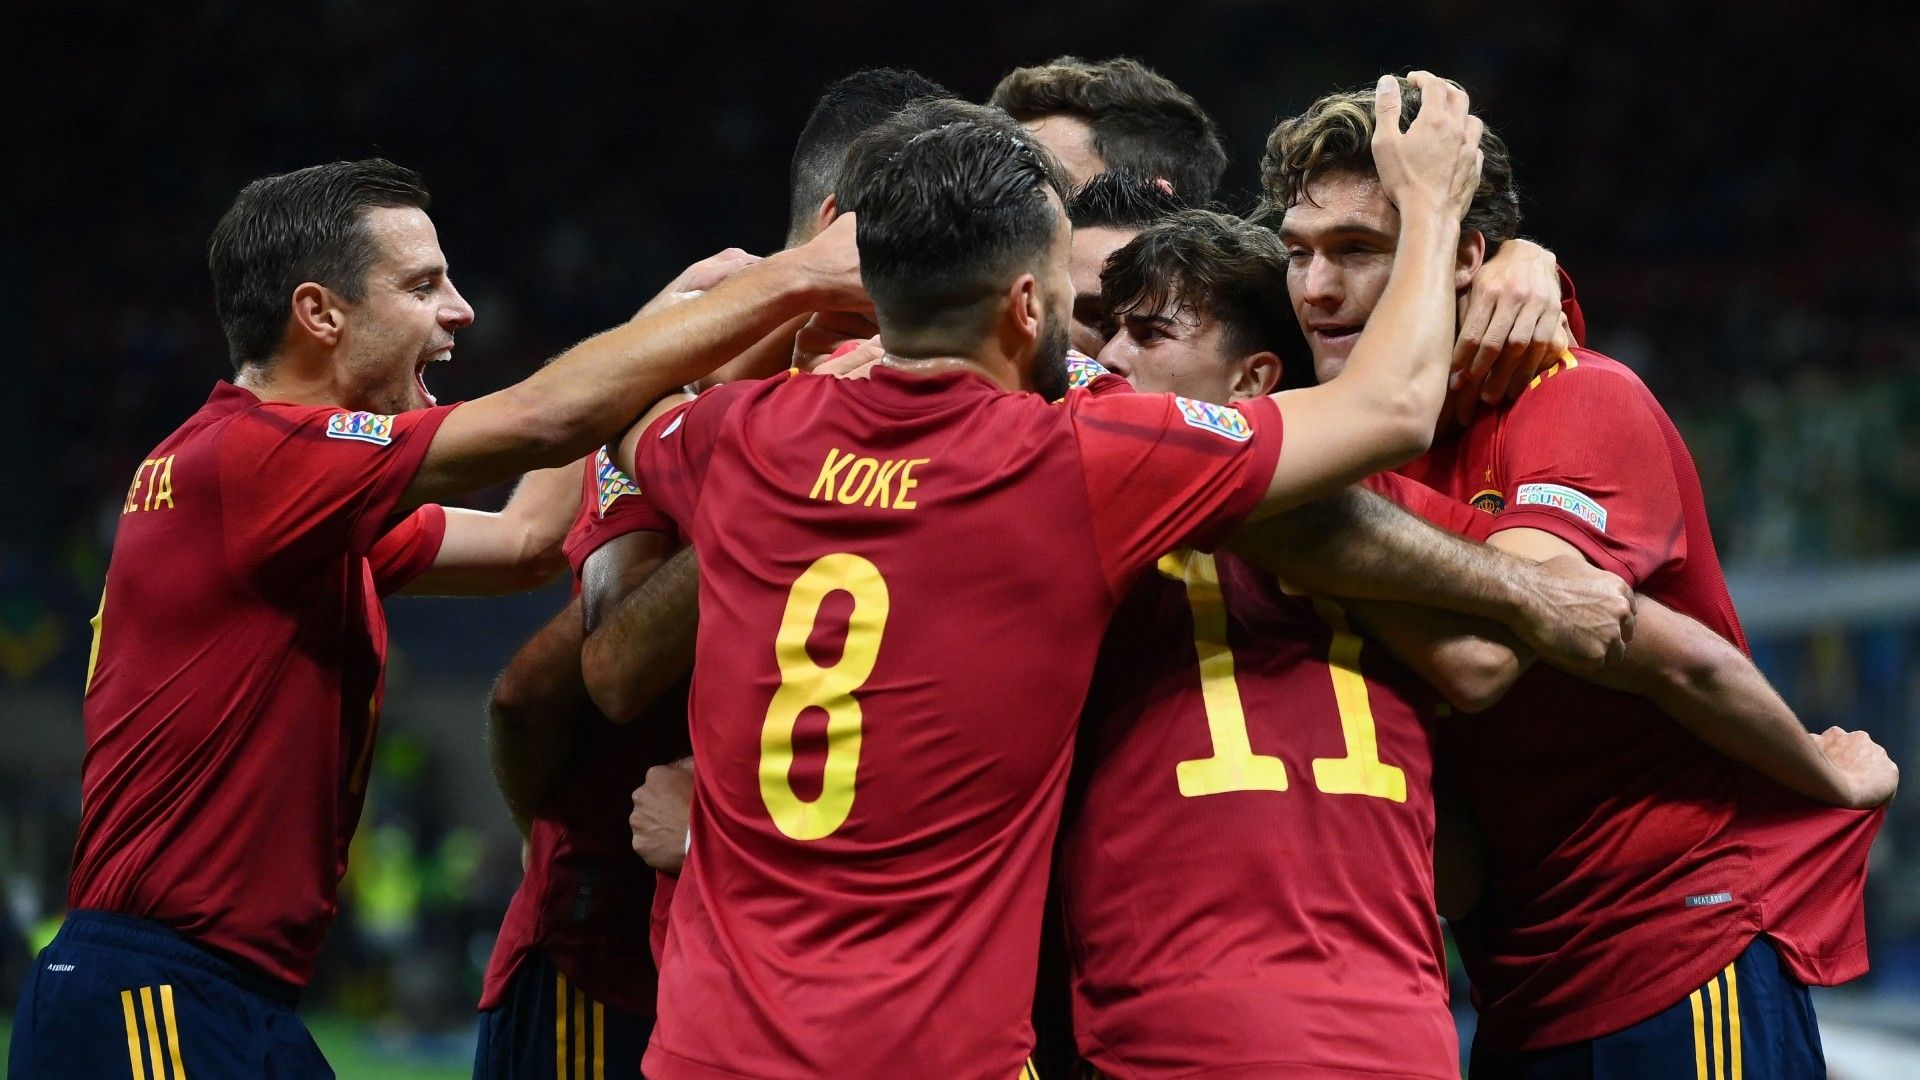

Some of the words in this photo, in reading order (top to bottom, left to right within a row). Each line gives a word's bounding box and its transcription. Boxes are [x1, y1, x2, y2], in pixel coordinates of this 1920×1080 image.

[809, 448, 930, 509] KOKE
[1520, 486, 1542, 494] UEFA
[1520, 494, 1605, 529] FOUNDATION
[759, 553, 889, 840] 8
[1158, 550, 1407, 804] 11
